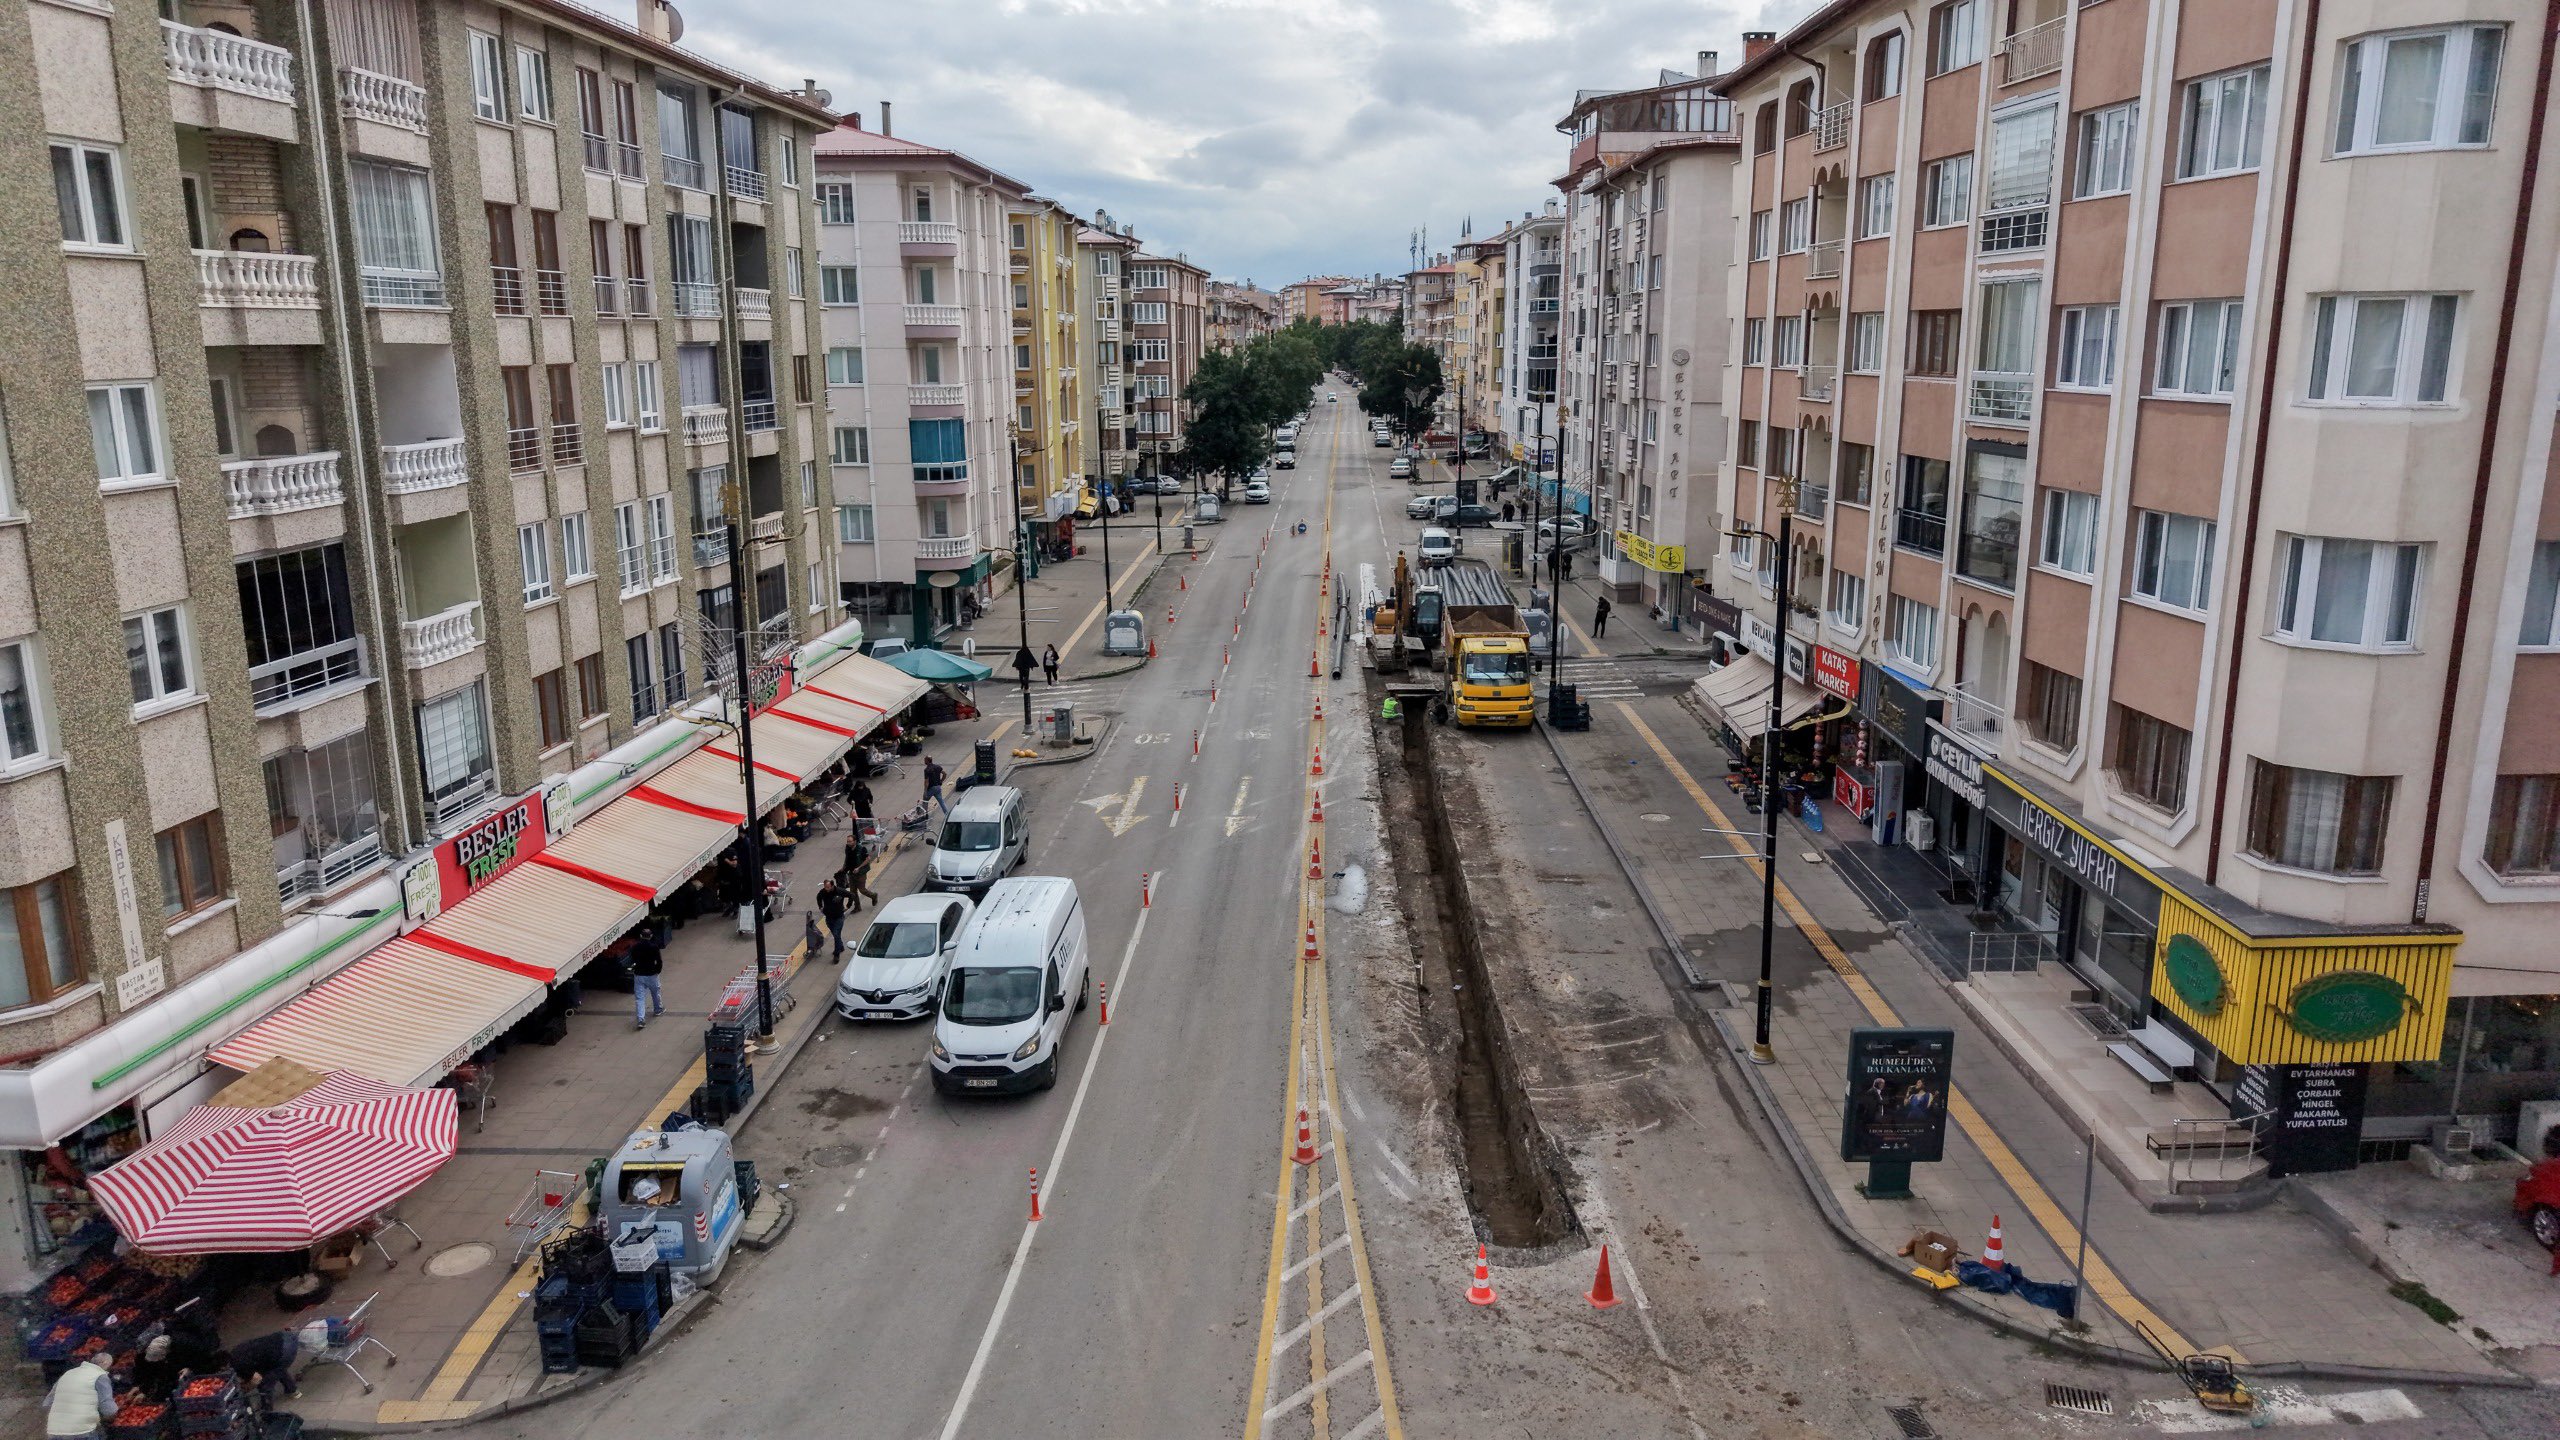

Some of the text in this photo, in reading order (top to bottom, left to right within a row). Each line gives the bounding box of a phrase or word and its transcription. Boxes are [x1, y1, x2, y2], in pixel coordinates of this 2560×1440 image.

[1669, 372, 1685, 498] EKER APT
[1875, 461, 1892, 577] ÖZLEM
[1822, 650, 1848, 677] KATAŞ
[1817, 669, 1850, 696] MARKET
[1941, 742, 1984, 785] CEYLİN
[1925, 756, 1987, 810] BAYAN KUAFÖRÜ
[468, 833, 521, 888] FRESH
[2019, 799, 2117, 897] NERGİZ YUFKA
[112, 833, 132, 914] KAPTAN
[410, 880, 439, 906] FRESH
[603, 926, 621, 945] FRESH
[471, 1025, 495, 1049] FRESH
[1866, 1065, 1937, 1073] BALKANLAR'A
[1871, 1056, 1934, 1066] RUMELİ'DEN
[2290, 1069, 2355, 1078] EV TARHANASI
[2241, 1082, 2267, 1107] MAKARNA
[2296, 1089, 2342, 1099] ÇORBALIK
[2305, 1079, 2336, 1087] SUBRA
[2293, 1109, 2340, 1118] MAKARNA
[2301, 1099, 2335, 1108] HİNGEL
[2285, 1119, 2348, 1128] YUFKA TATLISI
